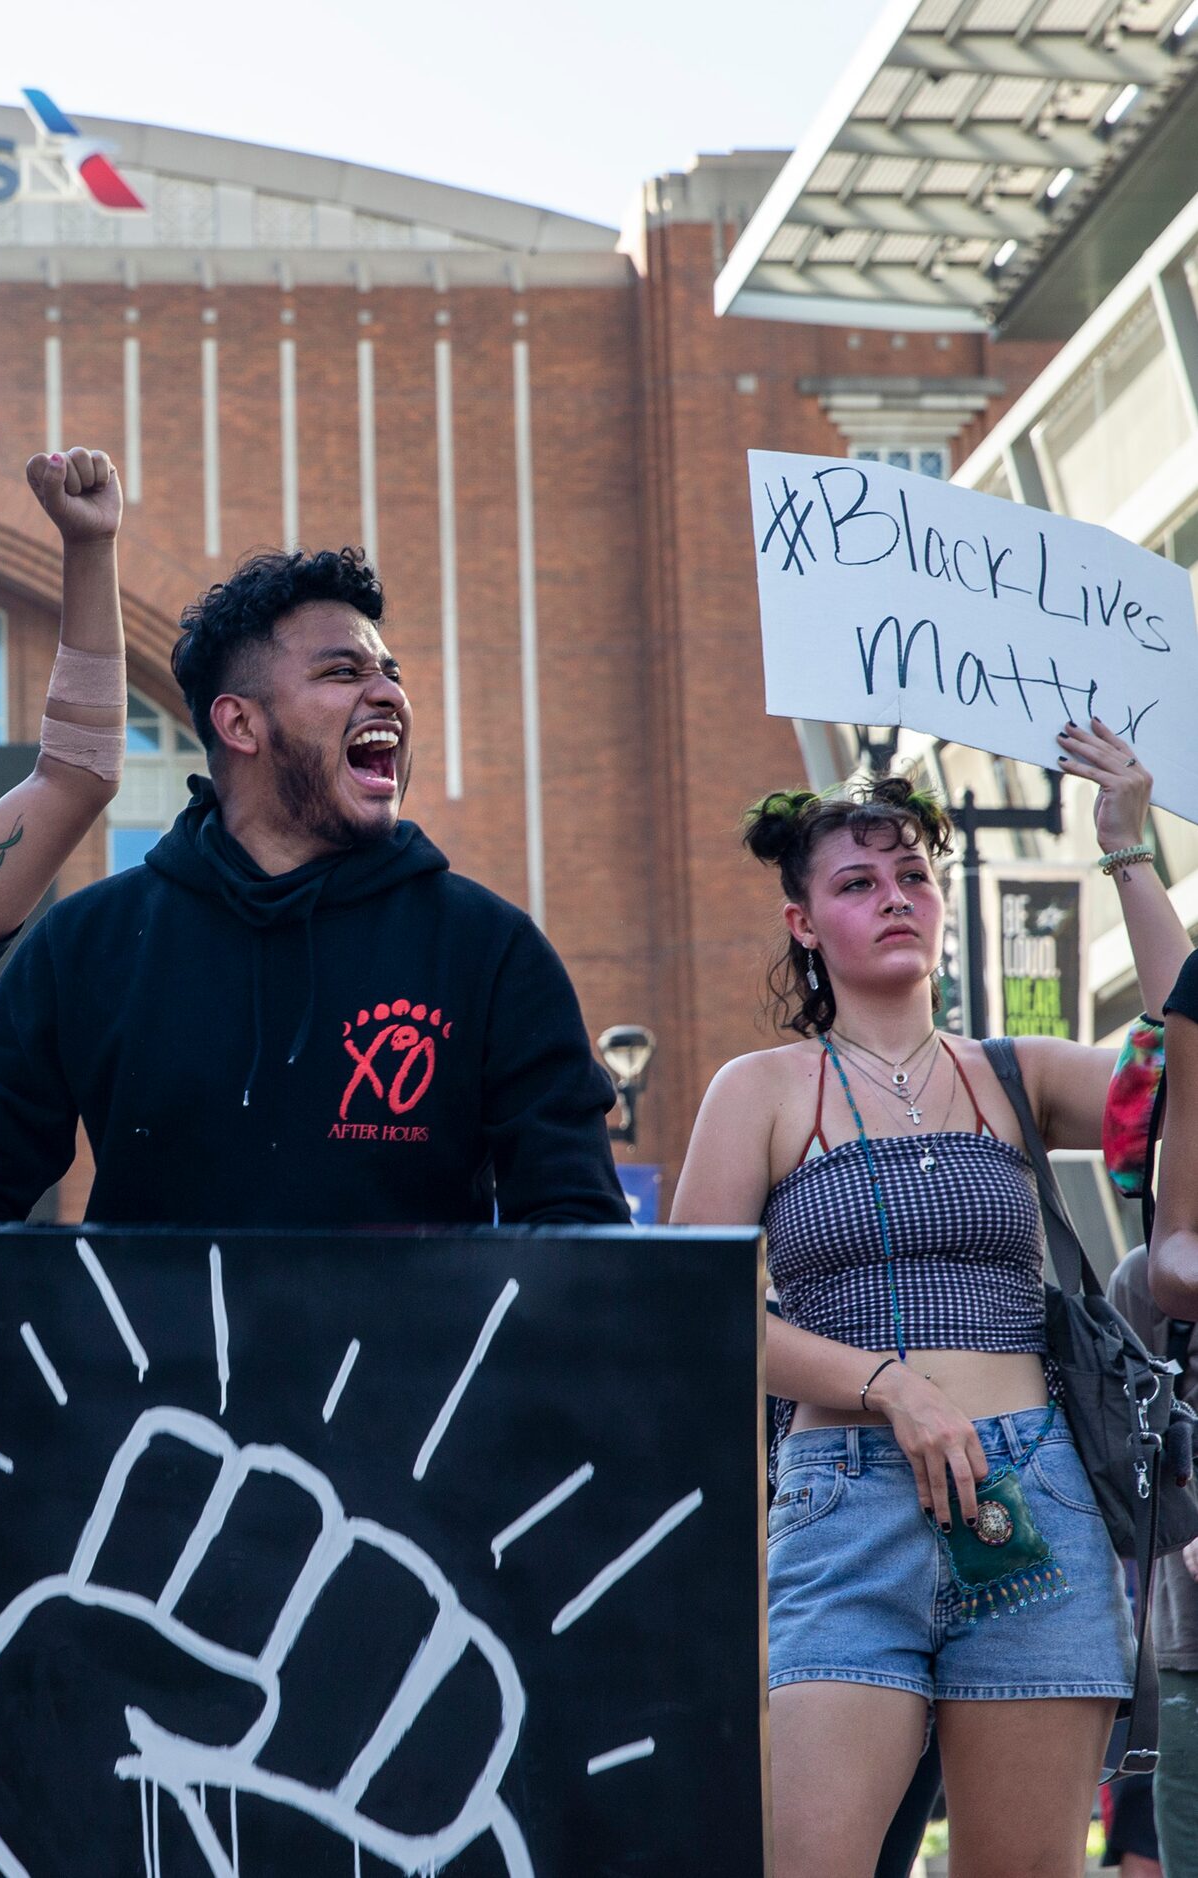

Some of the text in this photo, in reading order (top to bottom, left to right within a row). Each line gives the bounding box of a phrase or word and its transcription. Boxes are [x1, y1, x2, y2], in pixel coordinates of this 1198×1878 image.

[1037, 531, 1172, 652] Lives
[1002, 893, 1031, 936] BE
[339, 1024, 435, 1121] XO
[327, 1123, 430, 1142] AFTER HOURS
